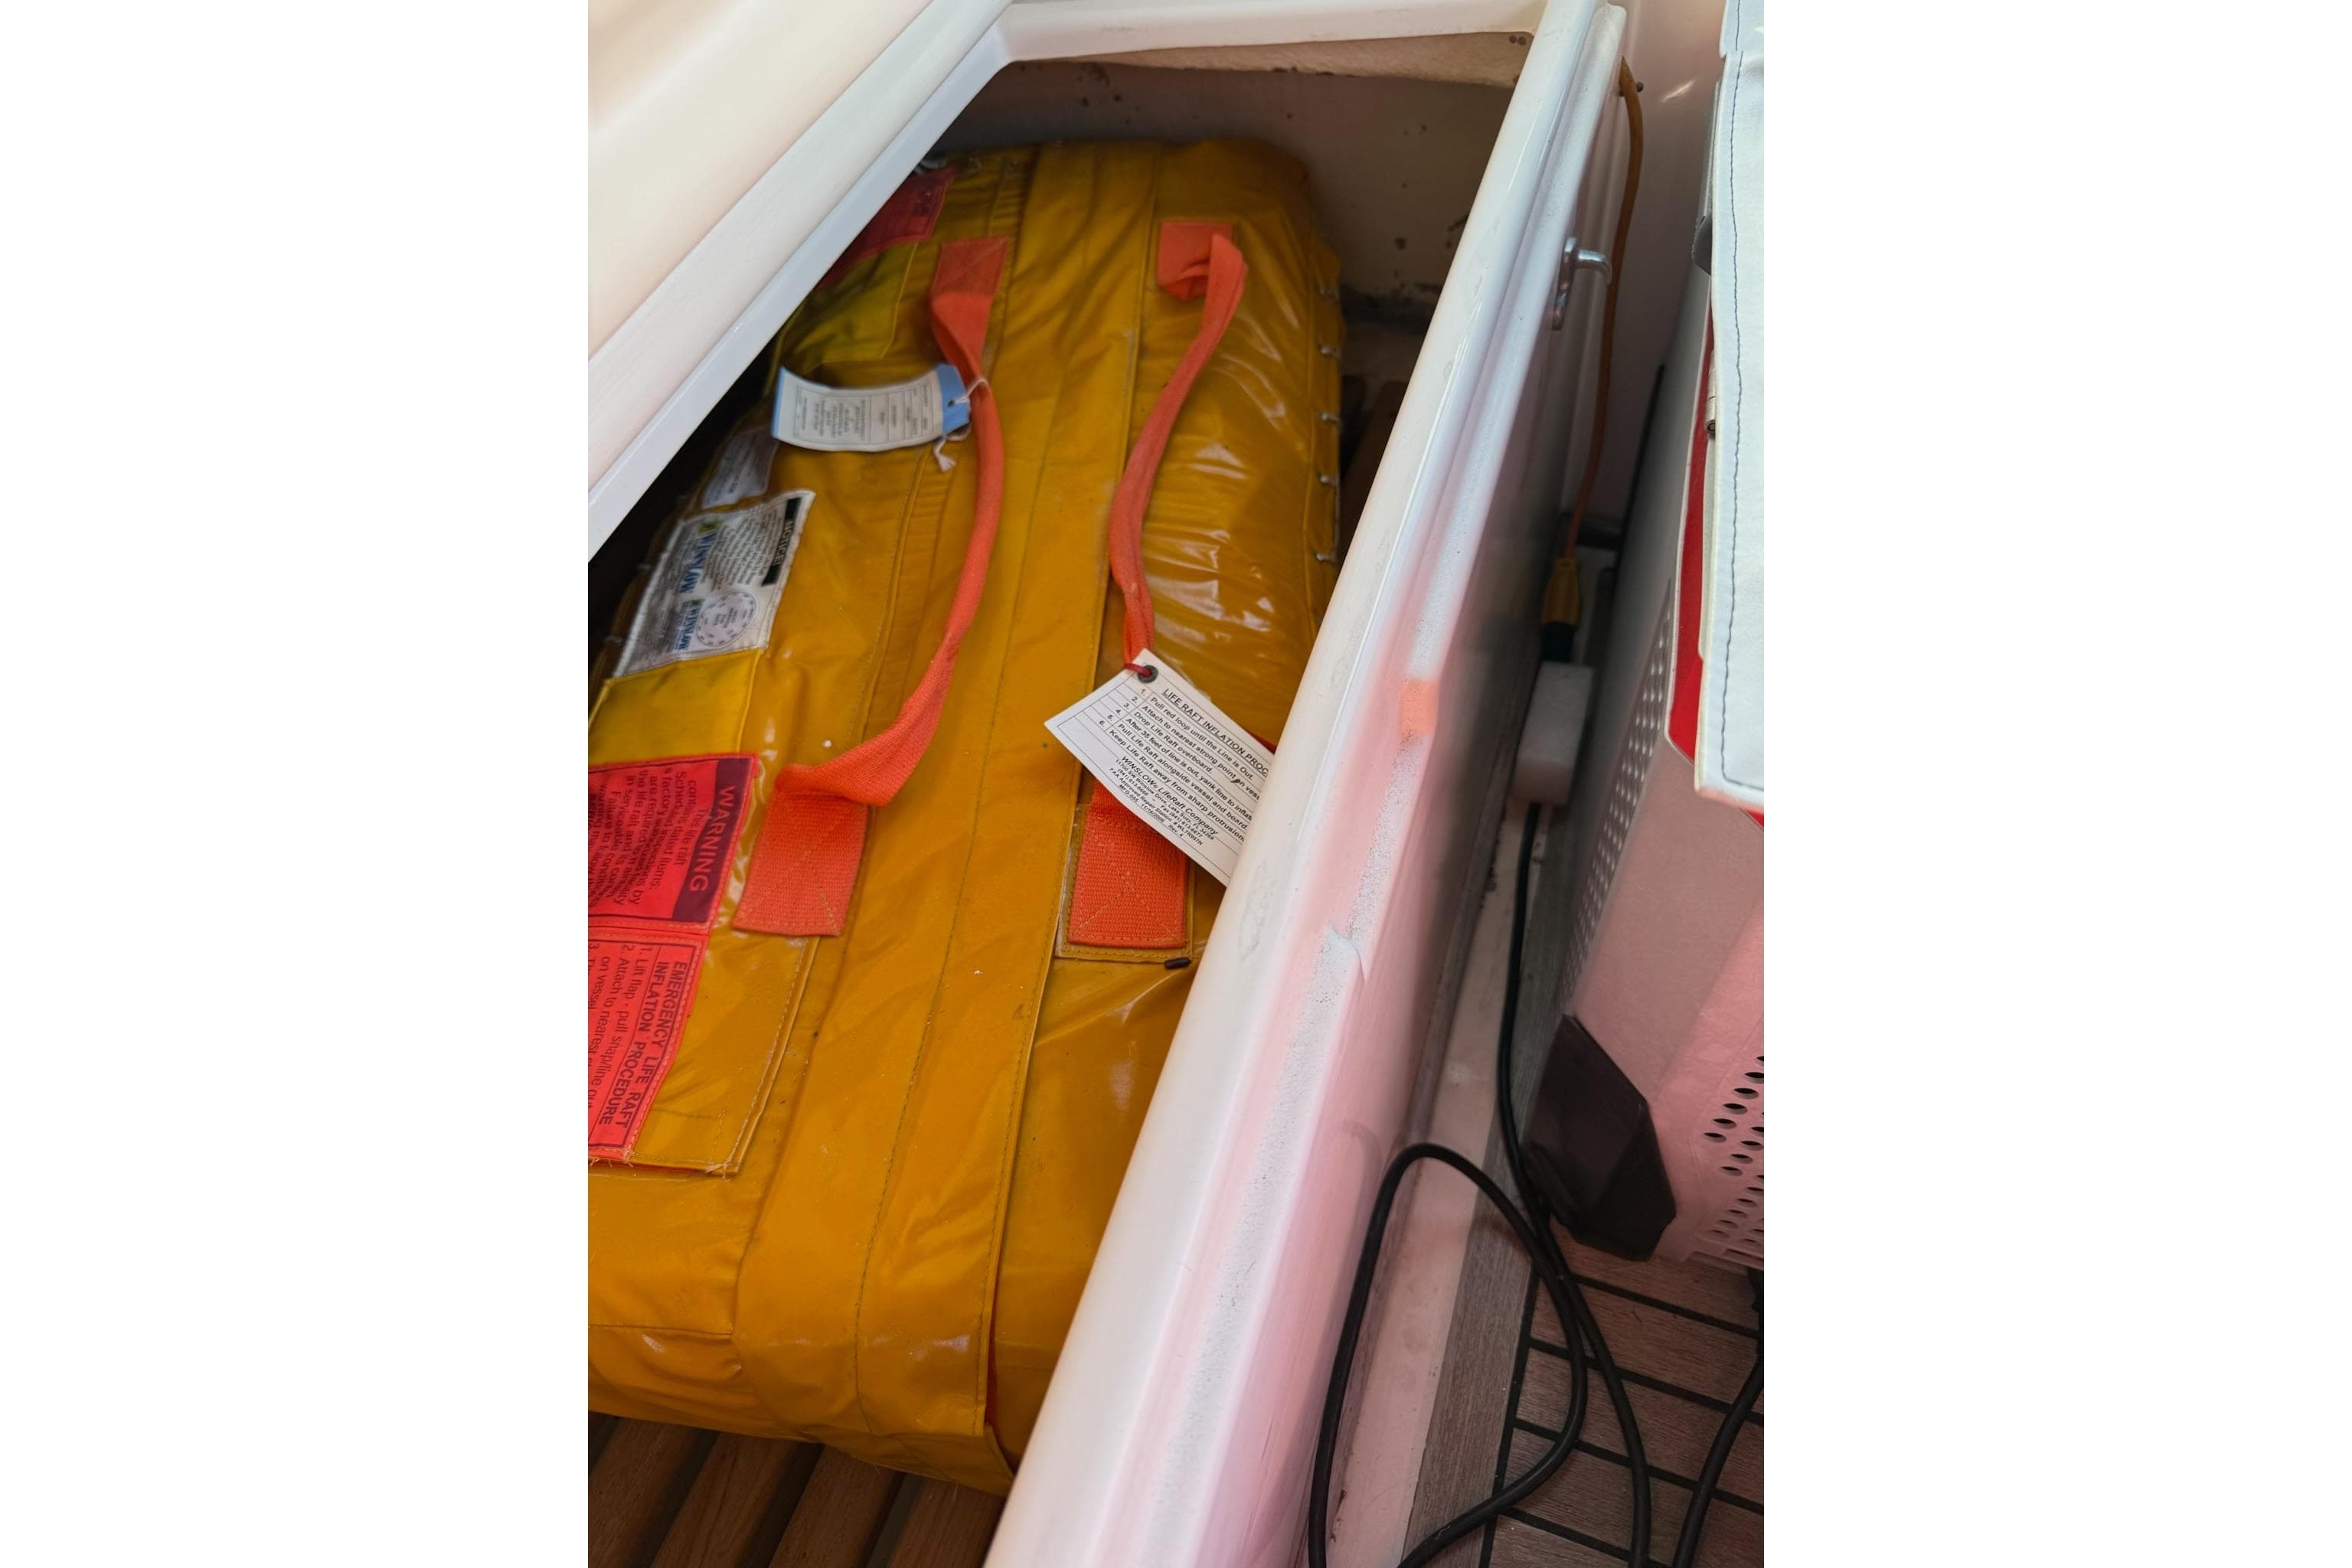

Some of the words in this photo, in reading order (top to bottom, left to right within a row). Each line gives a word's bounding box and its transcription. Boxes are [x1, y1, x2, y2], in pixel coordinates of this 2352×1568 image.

[678, 531, 717, 593] WINSLOW
[678, 607, 700, 649] WINSLOW
[1131, 695, 1138, 704] 2.
[1141, 704, 1164, 724] Attach
[1163, 721, 1171, 730] to
[1171, 727, 1196, 748] nearest
[1194, 745, 1218, 765] strong
[1217, 762, 1237, 779] point
[1132, 710, 1151, 727] Drop
[1150, 724, 1164, 737] Life
[1163, 733, 1178, 748] Raft
[1177, 743, 1214, 775] overboard.
[1139, 688, 1147, 696] 1.
[1149, 697, 1165, 710] Pull
[1163, 707, 1176, 719] red
[1174, 716, 1191, 731] loop
[1190, 727, 1206, 742] until
[1205, 740, 1217, 750] the
[1217, 748, 1233, 762] Line
[1232, 760, 1240, 768] is
[1162, 688, 1182, 706] LIFE
[1180, 702, 1204, 723] RAFT
[1202, 720, 1246, 756] INFLATION
[1243, 753, 1271, 776] PROC
[624, 773, 637, 786] in
[635, 769, 650, 789] the
[1098, 719, 1106, 727] 6.
[1107, 728, 1129, 747] Keep
[1125, 744, 1141, 757] Life
[1138, 755, 1155, 770] Raft
[1152, 767, 1172, 785] away
[1170, 780, 1188, 796] from
[1186, 793, 1209, 813] sharp
[1106, 714, 1114, 722] 5.
[1116, 722, 1133, 737] Pull
[1130, 733, 1145, 747] Life
[1143, 745, 1159, 760] Raft
[1156, 756, 1191, 785] alongside
[1189, 782, 1214, 802] vessel
[1211, 799, 1227, 813] and
[1125, 717, 1142, 732] After
[1140, 730, 1150, 739] 35
[1148, 736, 1162, 749] feet
[1160, 746, 1170, 755] of
[1168, 751, 1181, 763] line
[1185, 765, 1200, 778] out,
[1198, 775, 1216, 791] yank
[1214, 788, 1229, 801] line
[1227, 798, 1236, 807] to
[634, 789, 648, 808] life
[648, 774, 659, 795] are
[657, 776, 673, 817] factory
[662, 771, 686, 828] Scheduled
[678, 780, 697, 826] contains
[1109, 767, 1120, 777] FAA
[1118, 776, 1142, 797] Approved
[1139, 795, 1155, 809] Repair
[1155, 807, 1172, 822] Station
[1127, 769, 1136, 778] SW
[1135, 777, 1155, 794] Winslow
[1154, 792, 1168, 805] Drive,
[1168, 803, 1180, 814] Lake
[604, 789, 620, 831] Failure
[610, 787, 634, 851] serviceable
[627, 808, 642, 828] raft
[635, 796, 658, 844] required
[690, 806, 708, 828] This
[1158, 786, 1186, 809] LifeRaft
[1184, 807, 1219, 837] Company
[1160, 804, 1170, 813] Fax
[622, 829, 636, 852] and
[663, 825, 685, 856] dated
[674, 845, 689, 867] raft
[681, 828, 699, 845] life
[690, 786, 736, 891] WARNING
[650, 856, 672, 890] items.
[627, 887, 644, 905] by
[599, 956, 610, 971] on
[621, 945, 635, 954] 2.
[634, 959, 648, 975] Lift
[588, 975, 606, 1009] vessel
[609, 957, 629, 994] Attach
[623, 979, 642, 999] flap
[603, 997, 616, 1008] to
[638, 962, 670, 1032] INFLATION
[652, 962, 688, 1047] EMERGENCY
[588, 1011, 610, 1054] nearest
[616, 1011, 629, 1032] pull
[591, 1036, 622, 1086] snap/line
[635, 1057, 659, 1083] LIFE
[599, 1041, 647, 1125] PROCEDURE
[616, 1092, 641, 1128] RAFT
